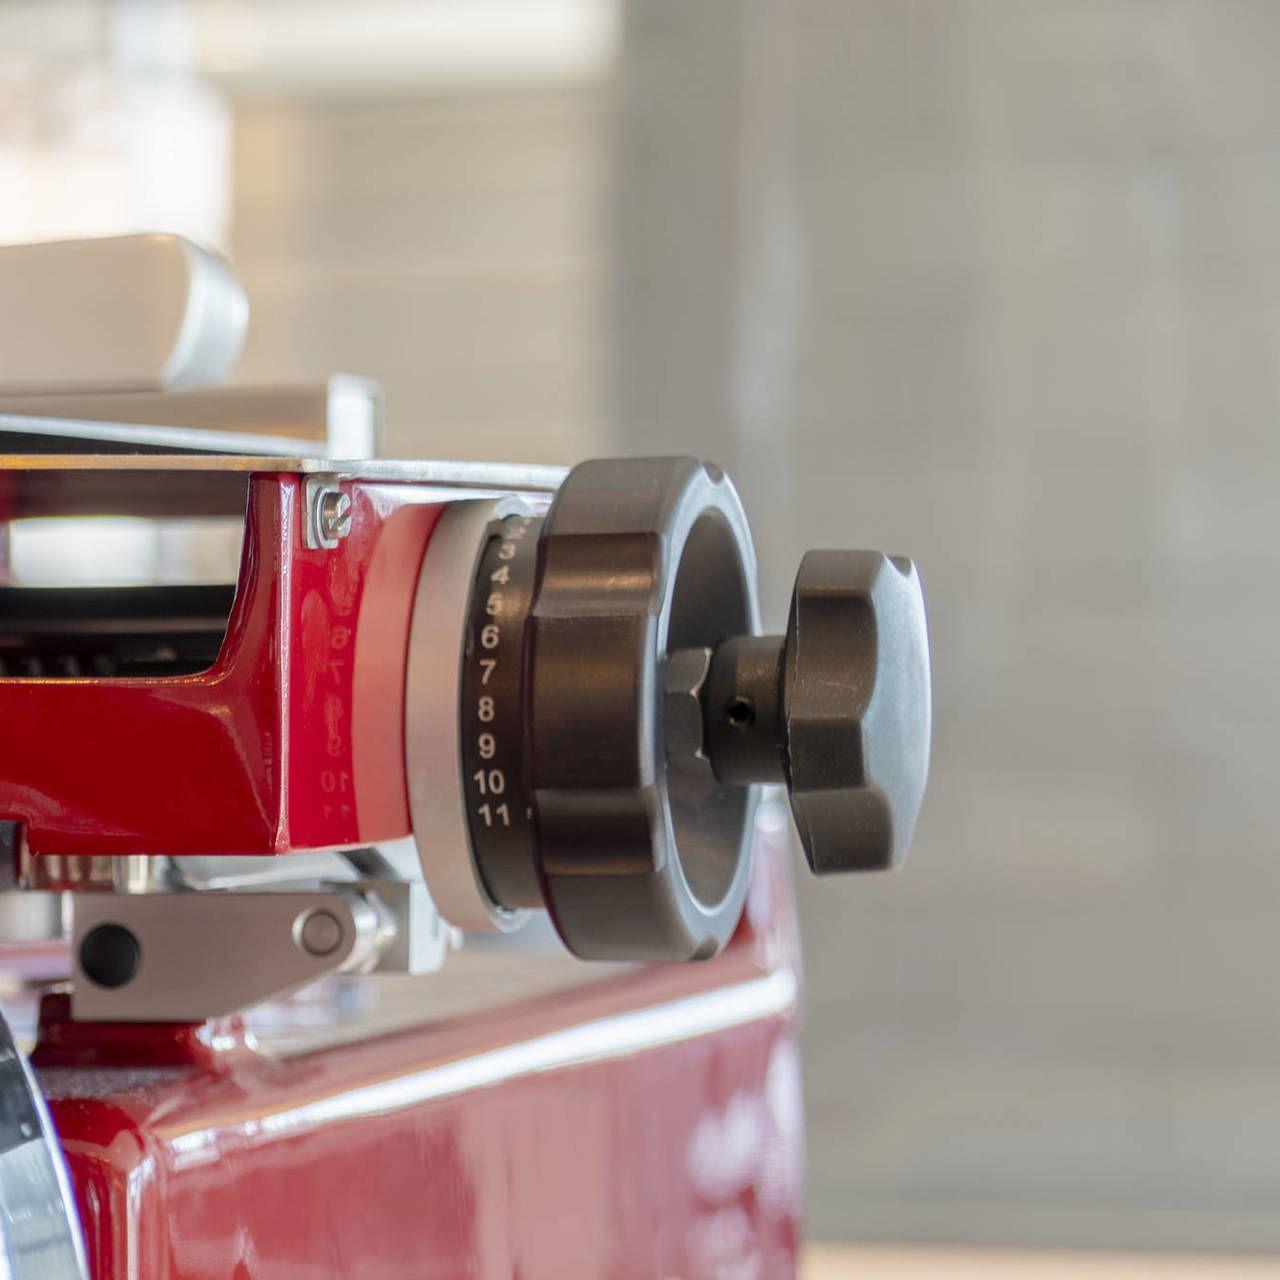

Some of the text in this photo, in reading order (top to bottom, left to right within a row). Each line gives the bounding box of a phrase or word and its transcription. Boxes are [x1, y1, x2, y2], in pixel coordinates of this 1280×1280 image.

[498, 543, 516, 560] 3
[490, 565, 510, 585] 4
[486, 591, 503, 615] 5
[481, 624, 500, 649] 6
[479, 659, 497, 686] 7
[478, 695, 495, 723] 8
[478, 732, 496, 760] 9
[473, 769, 506, 795] 10
[478, 803, 511, 828] 11
